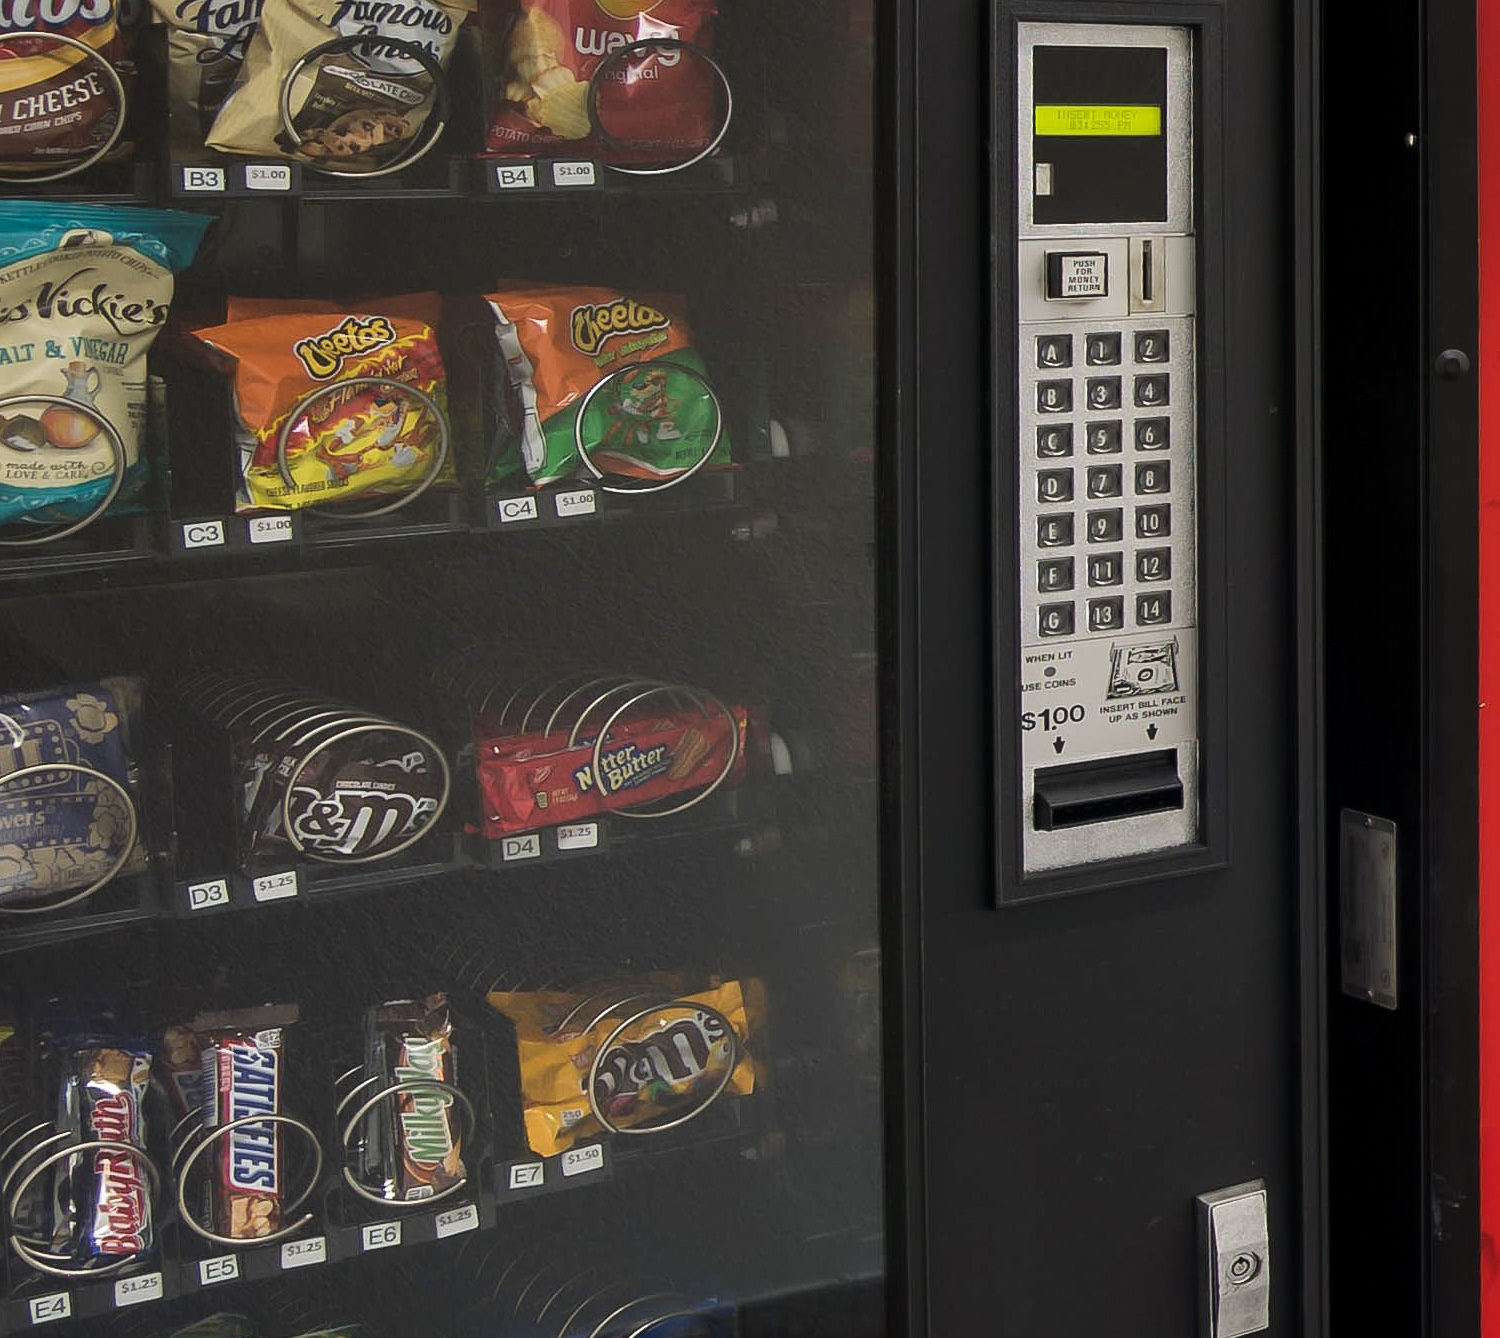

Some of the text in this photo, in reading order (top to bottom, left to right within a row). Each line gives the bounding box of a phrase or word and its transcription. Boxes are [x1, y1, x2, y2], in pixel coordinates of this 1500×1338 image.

[13, 72, 104, 121] CHEESE
[54, 112, 82, 127] CHIPS
[190, 171, 219, 187] B3
[251, 170, 286, 180] $1.00
[501, 170, 529, 184] B4
[559, 166, 590, 176] $1.00
[1073, 259, 1096, 268] PUSH
[1068, 275, 1100, 284] MONEY
[1075, 268, 1093, 276] FOR
[1067, 284, 1101, 293] RETURN
[36, 268, 170, 336] Vickie's
[573, 297, 669, 353] Cheetos
[45, 340, 65, 360] &
[69, 336, 129, 365] VINEGAR
[298, 318, 392, 378] Cheetos
[1046, 345, 1056, 361] A
[1098, 342, 1104, 359] 1
[1145, 339, 1153, 356] 2
[1047, 389, 1056, 406] B
[1097, 386, 1106, 402] 3
[1145, 383, 1153, 399] 4
[1048, 433, 1057, 449] C
[1097, 430, 1106, 446] 5
[1145, 426, 1153, 442] 6
[6, 460, 87, 471] made with
[6, 469, 38, 480] LOVE
[1098, 474, 1107, 490] 7
[1146, 471, 1154, 487] 8
[1048, 478, 1057, 494] D
[563, 494, 594, 506] $1.00
[503, 501, 532, 517] C4
[257, 519, 291, 533] $1.00
[1098, 519, 1106, 535] 9
[1142, 514, 1159, 530] 10
[188, 525, 219, 543] C3
[1049, 523, 1056, 540] E
[1095, 562, 1111, 578] 11
[1142, 557, 1159, 574] 12
[1049, 568, 1057, 584] F
[1095, 607, 1112, 623] 13
[1143, 601, 1159, 617] 14
[1048, 612, 1059, 629] G
[1025, 651, 1073, 663] WHEN LIT
[1021, 678, 1077, 692] USE COINS
[1100, 695, 1187, 714] INSERT BILL FACE
[1021, 704, 1086, 732] $1.00
[1109, 707, 1178, 724] UP AS SHOWN
[577, 746, 636, 791] Ntter
[609, 746, 666, 791] Butter
[560, 827, 591, 838] $1.25
[506, 839, 534, 856] D4
[259, 877, 293, 891] $1.25
[192, 885, 224, 905] D3
[567, 1150, 599, 1164] $1.50
[514, 1166, 540, 1184] E7
[438, 1209, 471, 1226] $1.25
[369, 1226, 397, 1246] E6
[287, 1243, 322, 1257] $1.25
[206, 1260, 235, 1280] E5
[121, 1279, 158, 1293] $1.25
[35, 1297, 66, 1319] E4
